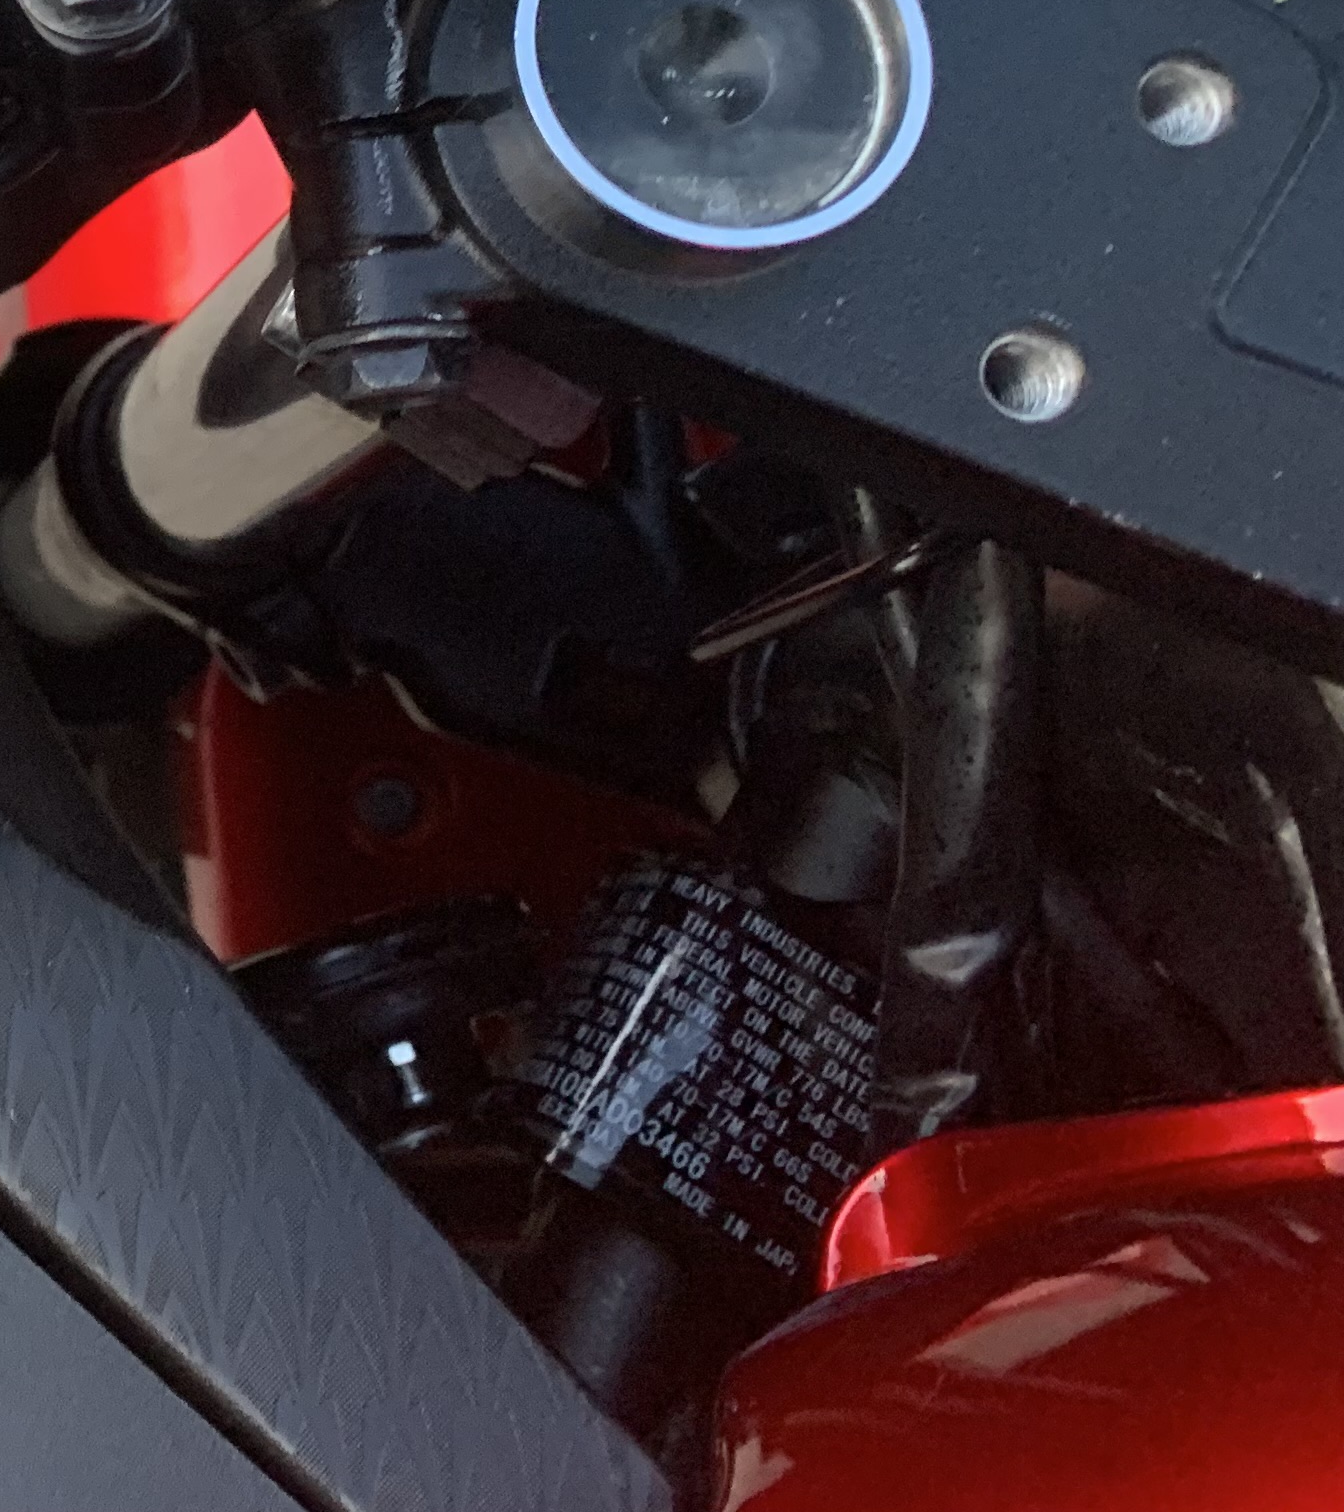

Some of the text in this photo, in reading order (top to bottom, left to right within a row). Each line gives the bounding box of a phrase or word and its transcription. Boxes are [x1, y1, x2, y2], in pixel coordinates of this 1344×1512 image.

[671, 875, 732, 913] HEAVY
[634, 942, 657, 966] IN
[657, 953, 737, 1011] FFECT
[744, 1008, 771, 1034] ON
[779, 1029, 815, 1065] THE
[654, 925, 733, 983] FEDERAL
[742, 978, 806, 1029] MOTOR
[814, 1023, 875, 1078] VEHIC
[682, 910, 732, 950] THIS
[740, 943, 824, 1009] VEHICLE
[830, 1004, 880, 1042] CONF
[683, 1056, 710, 1083] AT
[716, 1080, 745, 1106] 28
[732, 1028, 783, 1072] GVWR
[790, 1065, 826, 1101] 776
[658, 1101, 686, 1126] AT
[774, 1148, 812, 1183] 66S
[664, 1172, 715, 1219] MADE
[723, 1212, 750, 1241] IN
